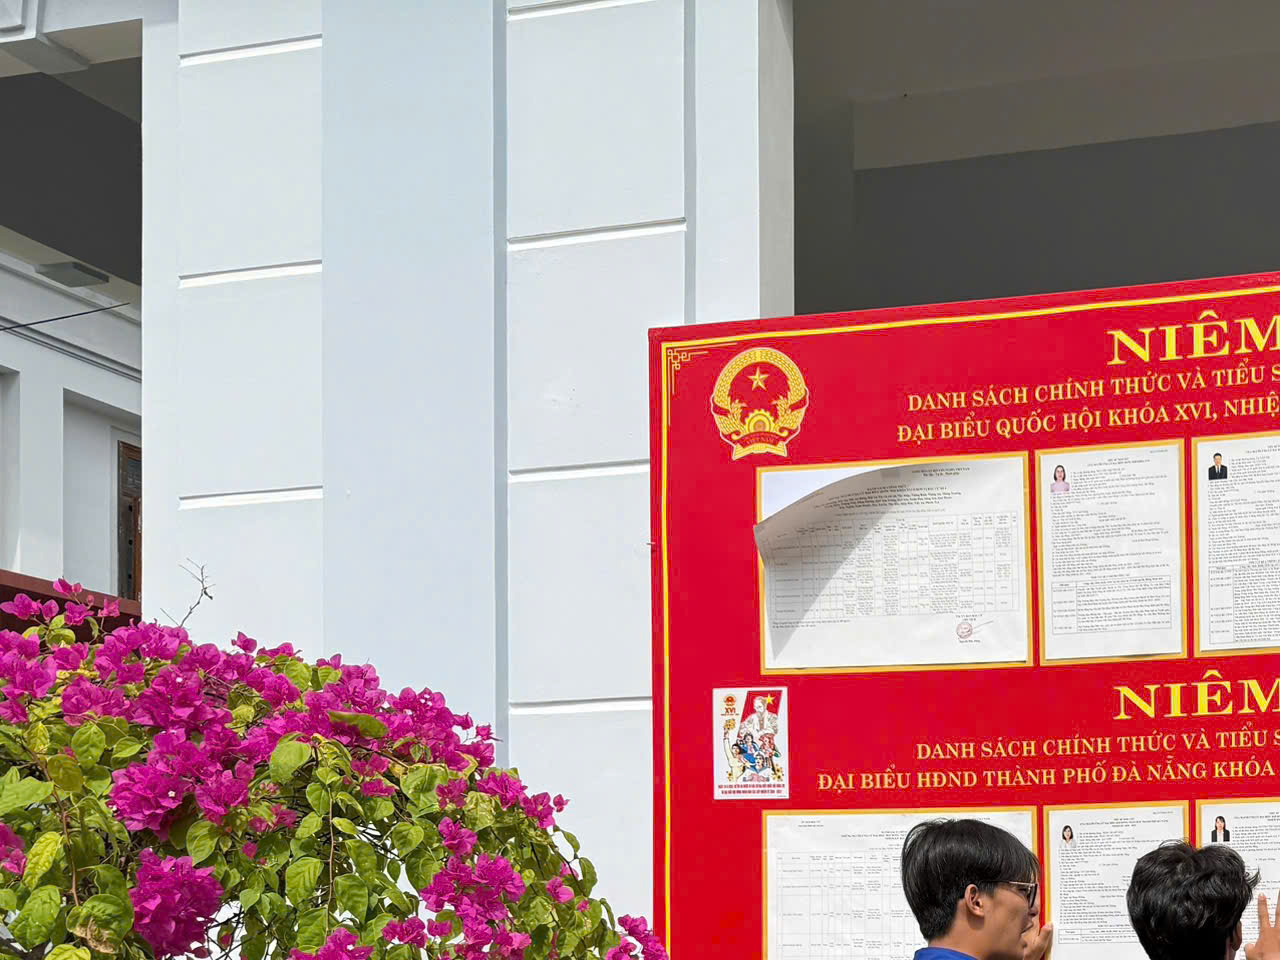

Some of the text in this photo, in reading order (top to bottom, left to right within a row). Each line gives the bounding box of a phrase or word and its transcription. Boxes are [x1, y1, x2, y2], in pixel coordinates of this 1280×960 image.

[908, 392, 966, 411] DANH
[972, 385, 1027, 407] SÁCH
[1035, 378, 1104, 402] CHÍNH
[1111, 371, 1170, 395] THỨC
[1177, 367, 1206, 390] VÀ
[1212, 358, 1264, 386] TIỂU
[898, 424, 933, 445] ĐẠI
[940, 411, 990, 439] BIỂU
[996, 409, 1055, 438] QUỐC
[1063, 407, 1101, 432] HỘI
[1109, 402, 1169, 426] KHÓA
[1175, 402, 1217, 421] XVI,
[917, 743, 975, 759] DANH
[982, 737, 1036, 757] SÁCH
[1043, 734, 1111, 755] CHÍNH
[1117, 730, 1175, 752] THỨC
[1182, 728, 1210, 749] VÀ
[1216, 722, 1267, 748] TIỂU
[818, 774, 854, 793] ĐẠI
[861, 764, 910, 788] BIỂU
[917, 772, 977, 787] HĐND
[983, 765, 1055, 786] THÀNH
[1064, 760, 1106, 784] PHỐ
[1112, 761, 1141, 782] ĐÀ
[1148, 756, 1206, 780] NẴNG
[1214, 756, 1275, 777] KHÓA
